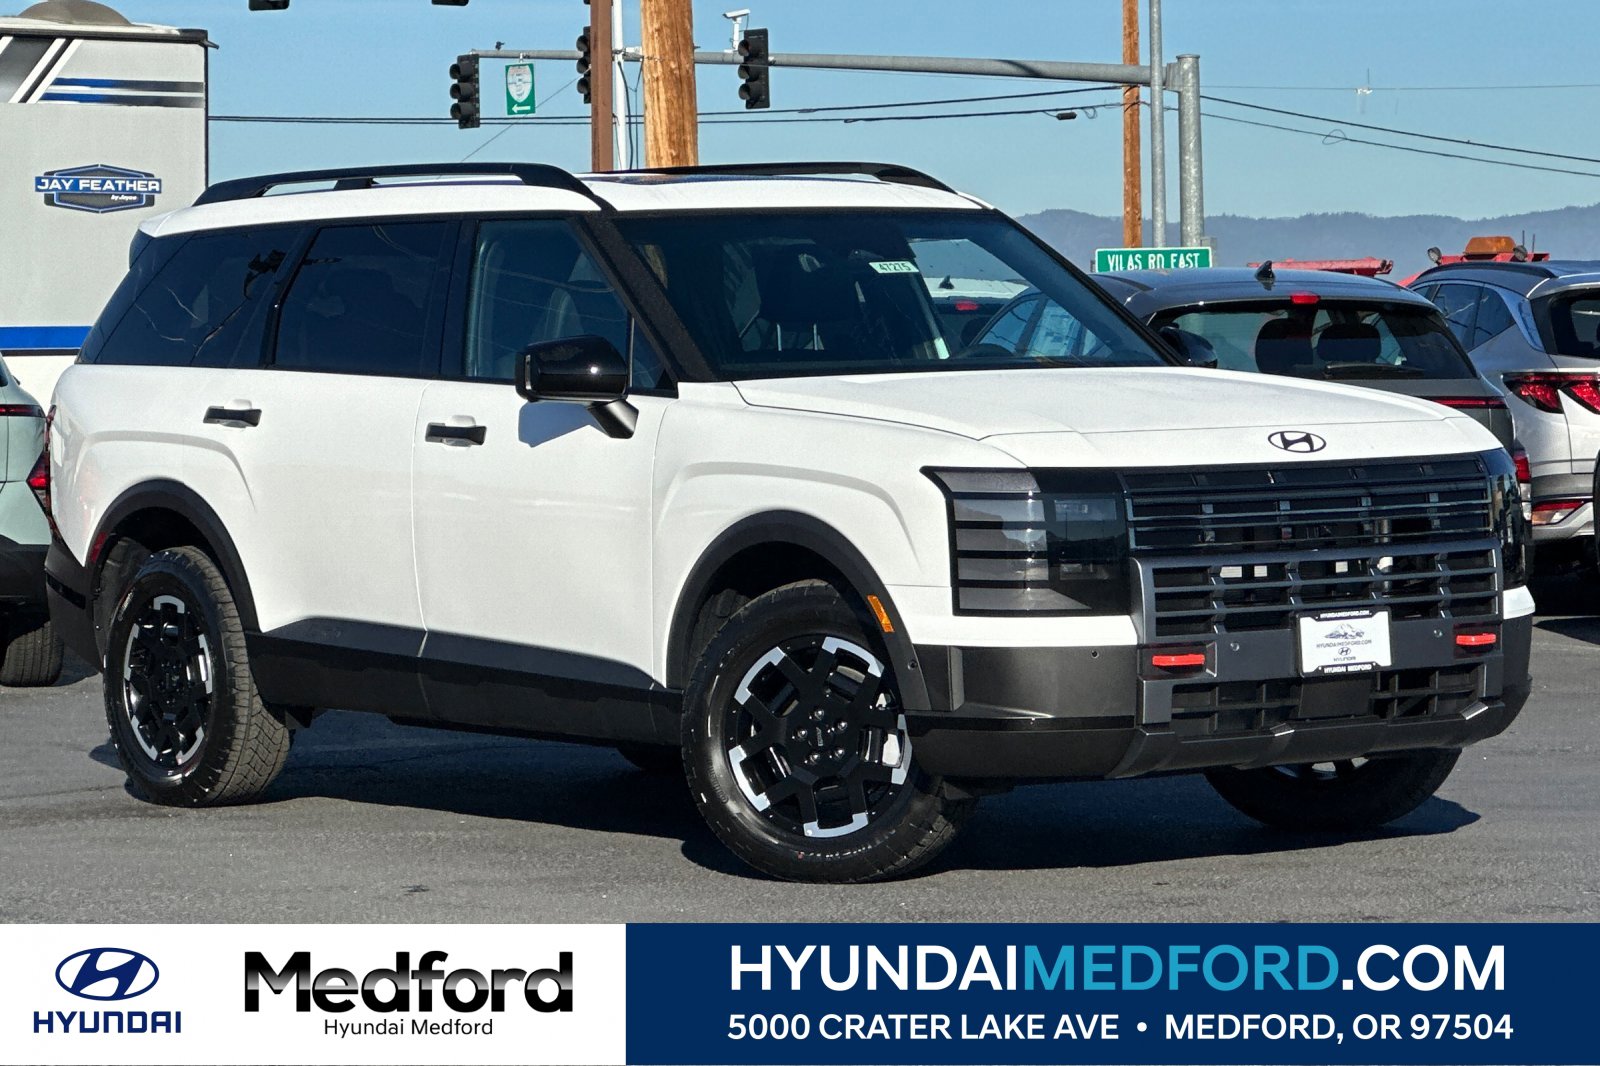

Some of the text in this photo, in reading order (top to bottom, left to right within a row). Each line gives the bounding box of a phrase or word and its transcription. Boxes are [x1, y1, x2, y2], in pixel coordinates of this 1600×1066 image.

[37, 179, 160, 192] JAY FEATHER
[878, 262, 912, 271] 47275
[1107, 252, 1200, 272] VILAS RD EAST
